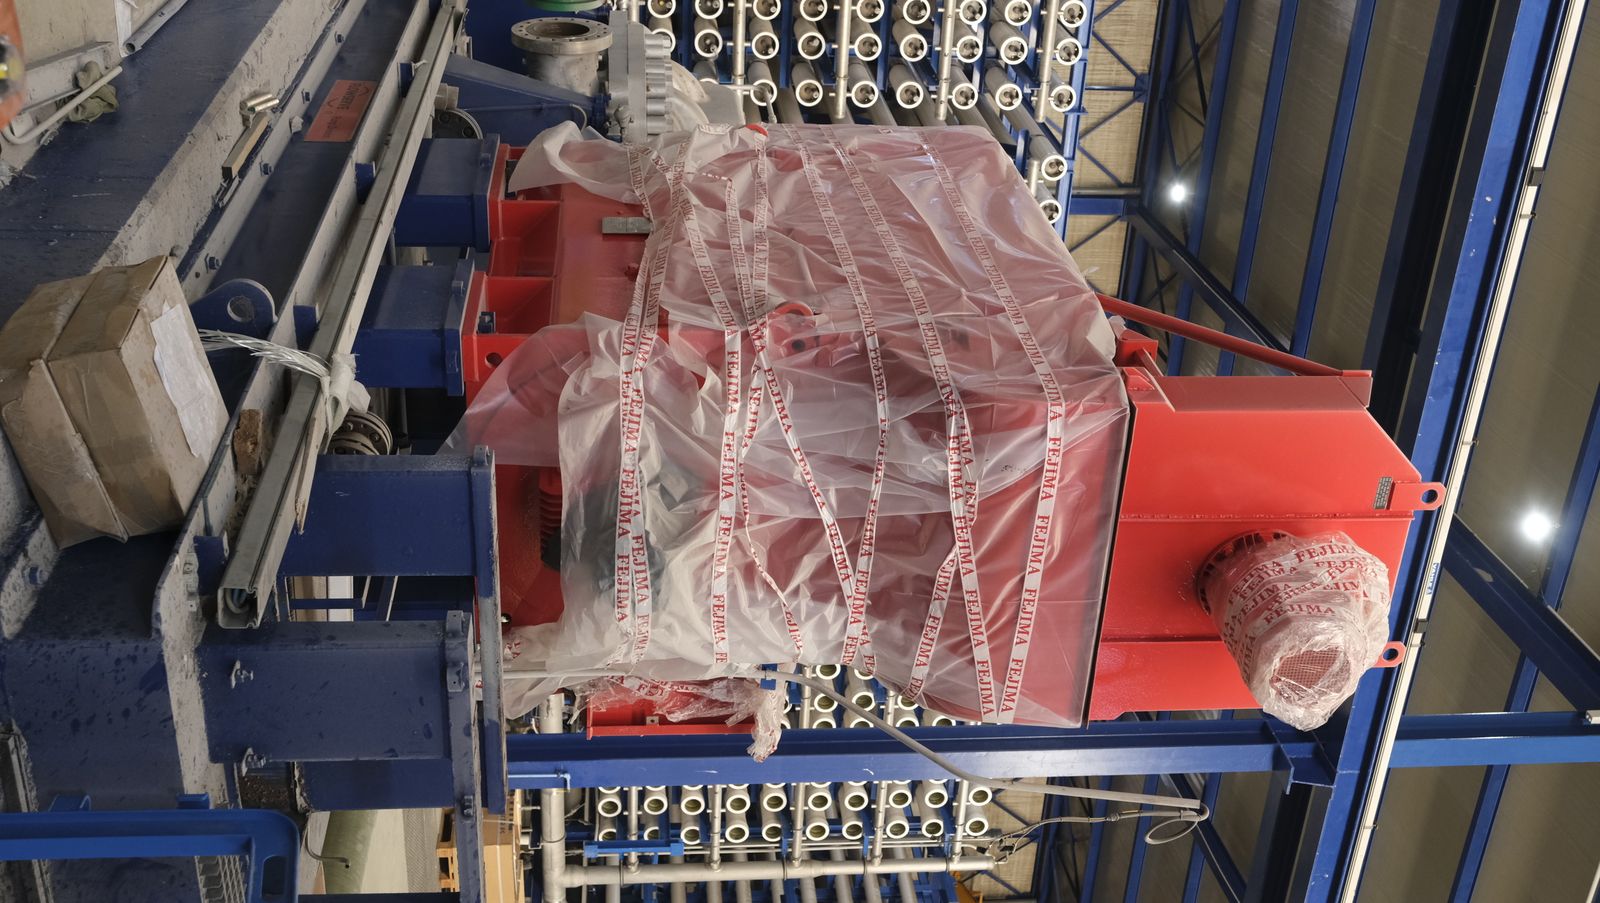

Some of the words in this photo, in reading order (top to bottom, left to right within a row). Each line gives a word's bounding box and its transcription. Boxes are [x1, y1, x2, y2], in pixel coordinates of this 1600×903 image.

[824, 217, 842, 239] FEJIMA
[878, 230, 897, 253] FEJIMA
[957, 211, 976, 233] FEJIMA
[835, 243, 853, 267] FEJIMA
[892, 257, 913, 282] FEJIMA
[970, 237, 991, 260] FEJIMA
[645, 282, 659, 318] FEJIMA
[699, 265, 721, 295] FEJIMA
[985, 265, 1007, 290] FEJIMA
[714, 301, 739, 337] FEJIMA
[858, 302, 877, 337] FEJIMA
[906, 287, 929, 316] FEJIMA
[1001, 295, 1024, 325] FEJIMA
[622, 313, 639, 357] FEJIMA
[921, 322, 942, 357] FEJIMA
[1019, 331, 1045, 366] FEJIMA
[727, 351, 739, 414] FEJIMA
[624, 388, 643, 454] FEJIMA
[742, 387, 762, 448] FEJIMA
[721, 431, 735, 501] FEJIMA
[764, 368, 793, 434] FEJIMA
[826, 522, 851, 582] FEJIMA
[948, 436, 964, 502] FEJIMA
[1040, 437, 1061, 501] FEJIMA
[617, 468, 636, 538] FEJIMA
[632, 534, 649, 604] FEJIMA
[714, 514, 733, 581] FEJIMA
[954, 515, 974, 576] FEJIMA
[1027, 515, 1050, 576] FEJIMA
[1295, 544, 1356, 563] FEJIM
[617, 554, 630, 622] FEJIMA
[849, 569, 869, 625] FEJIMA
[934, 558, 956, 600] EJIMA
[1240, 567, 1297, 600] FEJIMA
[712, 594, 726, 645] FEJIMA
[965, 590, 986, 648] FEJIMA
[1015, 589, 1037, 646] FEJIMA
[1264, 603, 1335, 624] FEJIMA
[915, 614, 941, 667] FEJIMA
[976, 660, 995, 715] FEJIMA
[1001, 658, 1024, 712] FEJIMA
